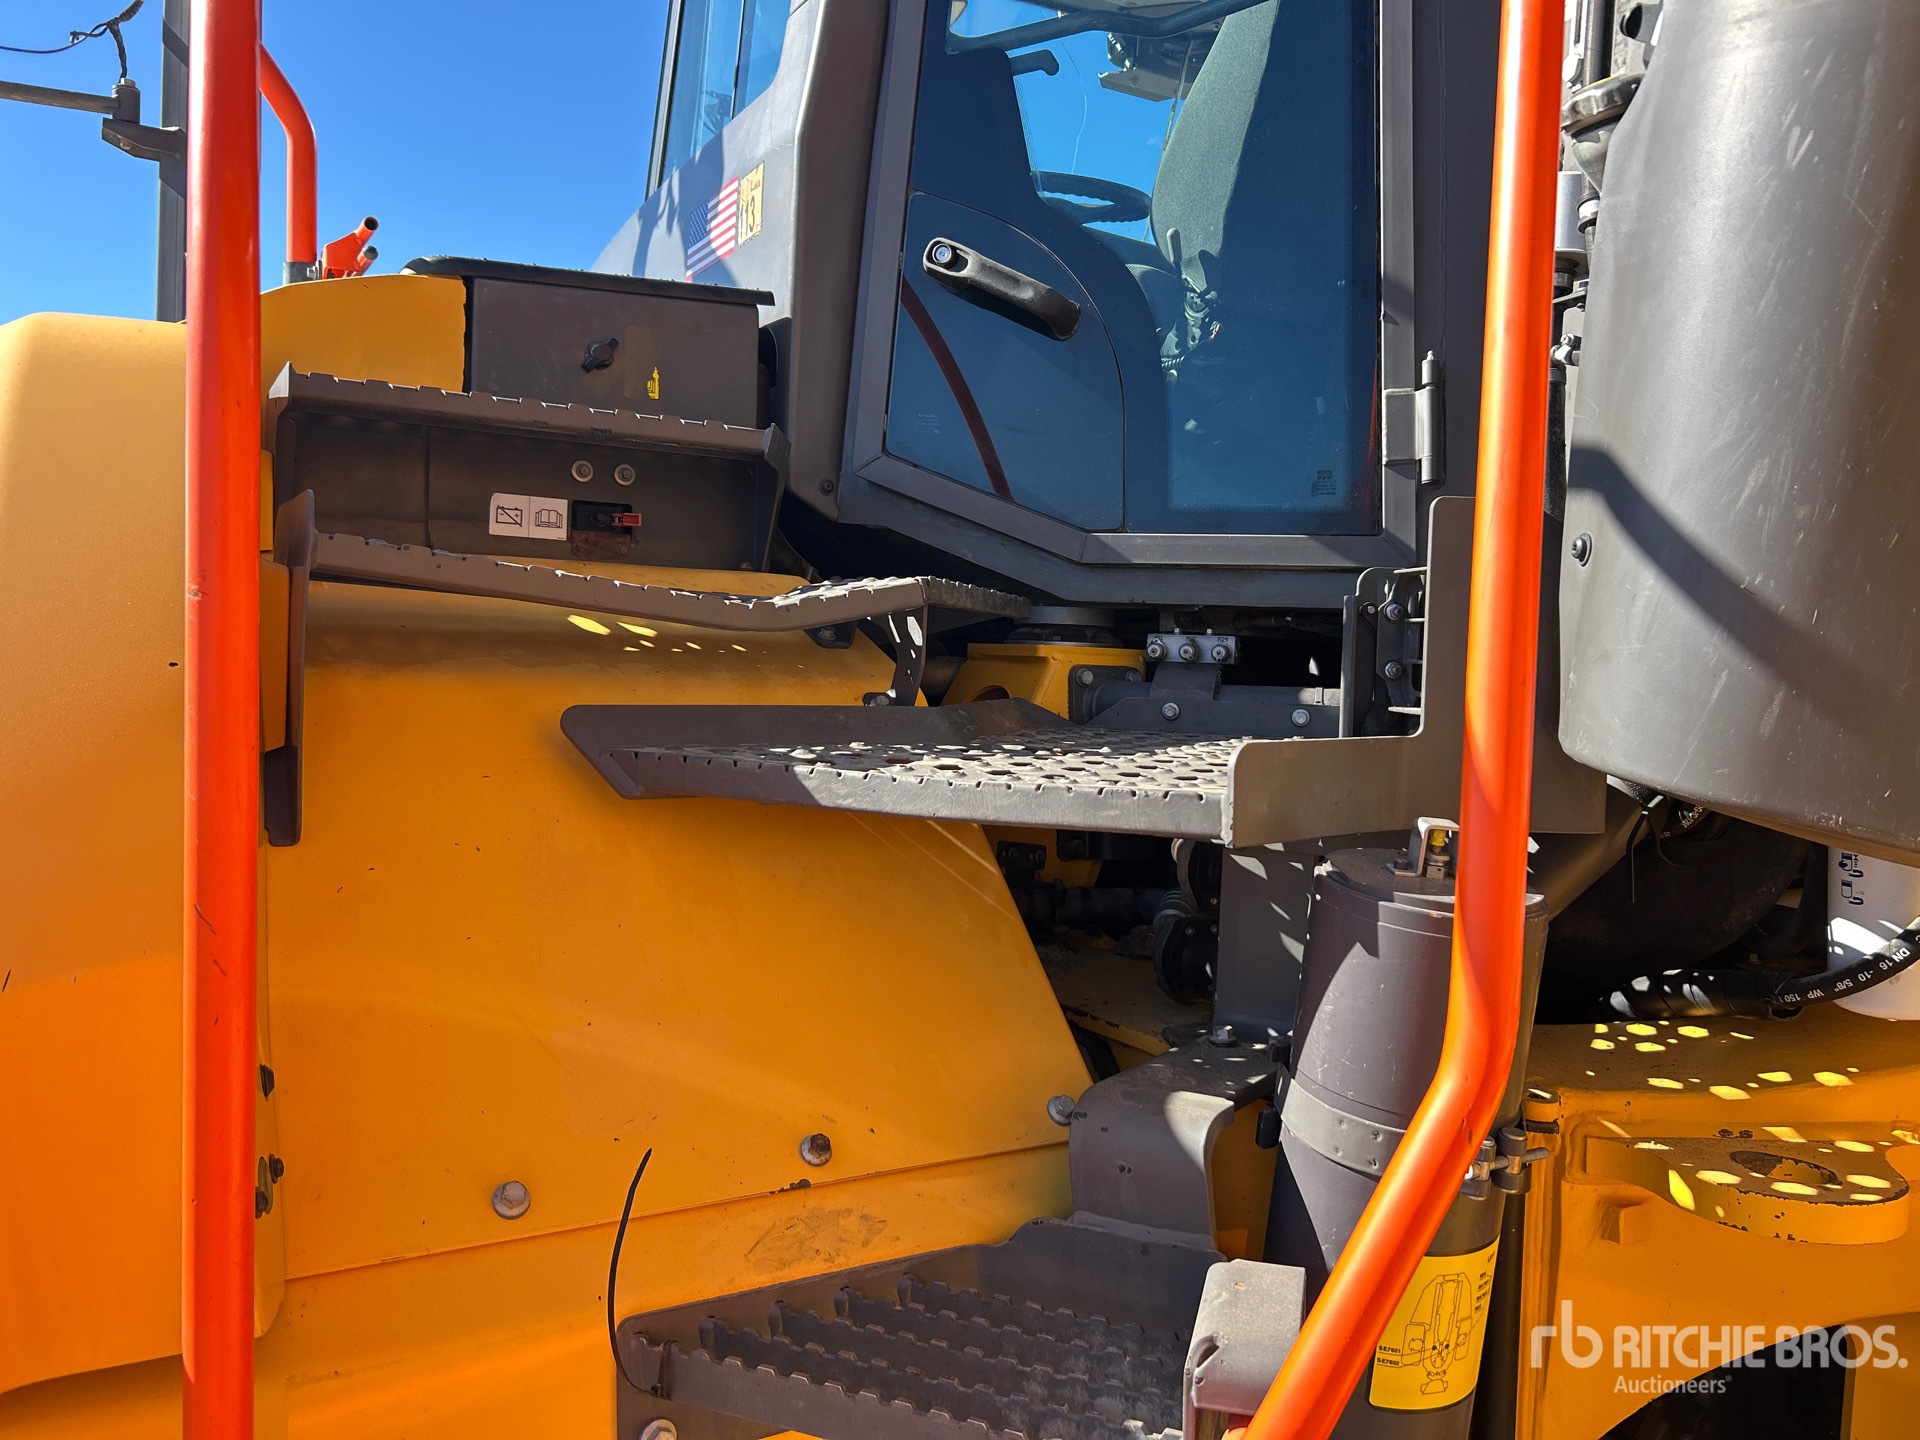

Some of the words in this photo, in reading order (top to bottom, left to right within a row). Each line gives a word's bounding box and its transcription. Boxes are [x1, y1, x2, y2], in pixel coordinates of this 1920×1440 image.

[1891, 946, 1910, 963] DN
[1878, 959, 1893, 971] 16
[1857, 969, 1874, 981] -10
[1784, 993, 1801, 1003] 150
[1806, 988, 1825, 999] WP
